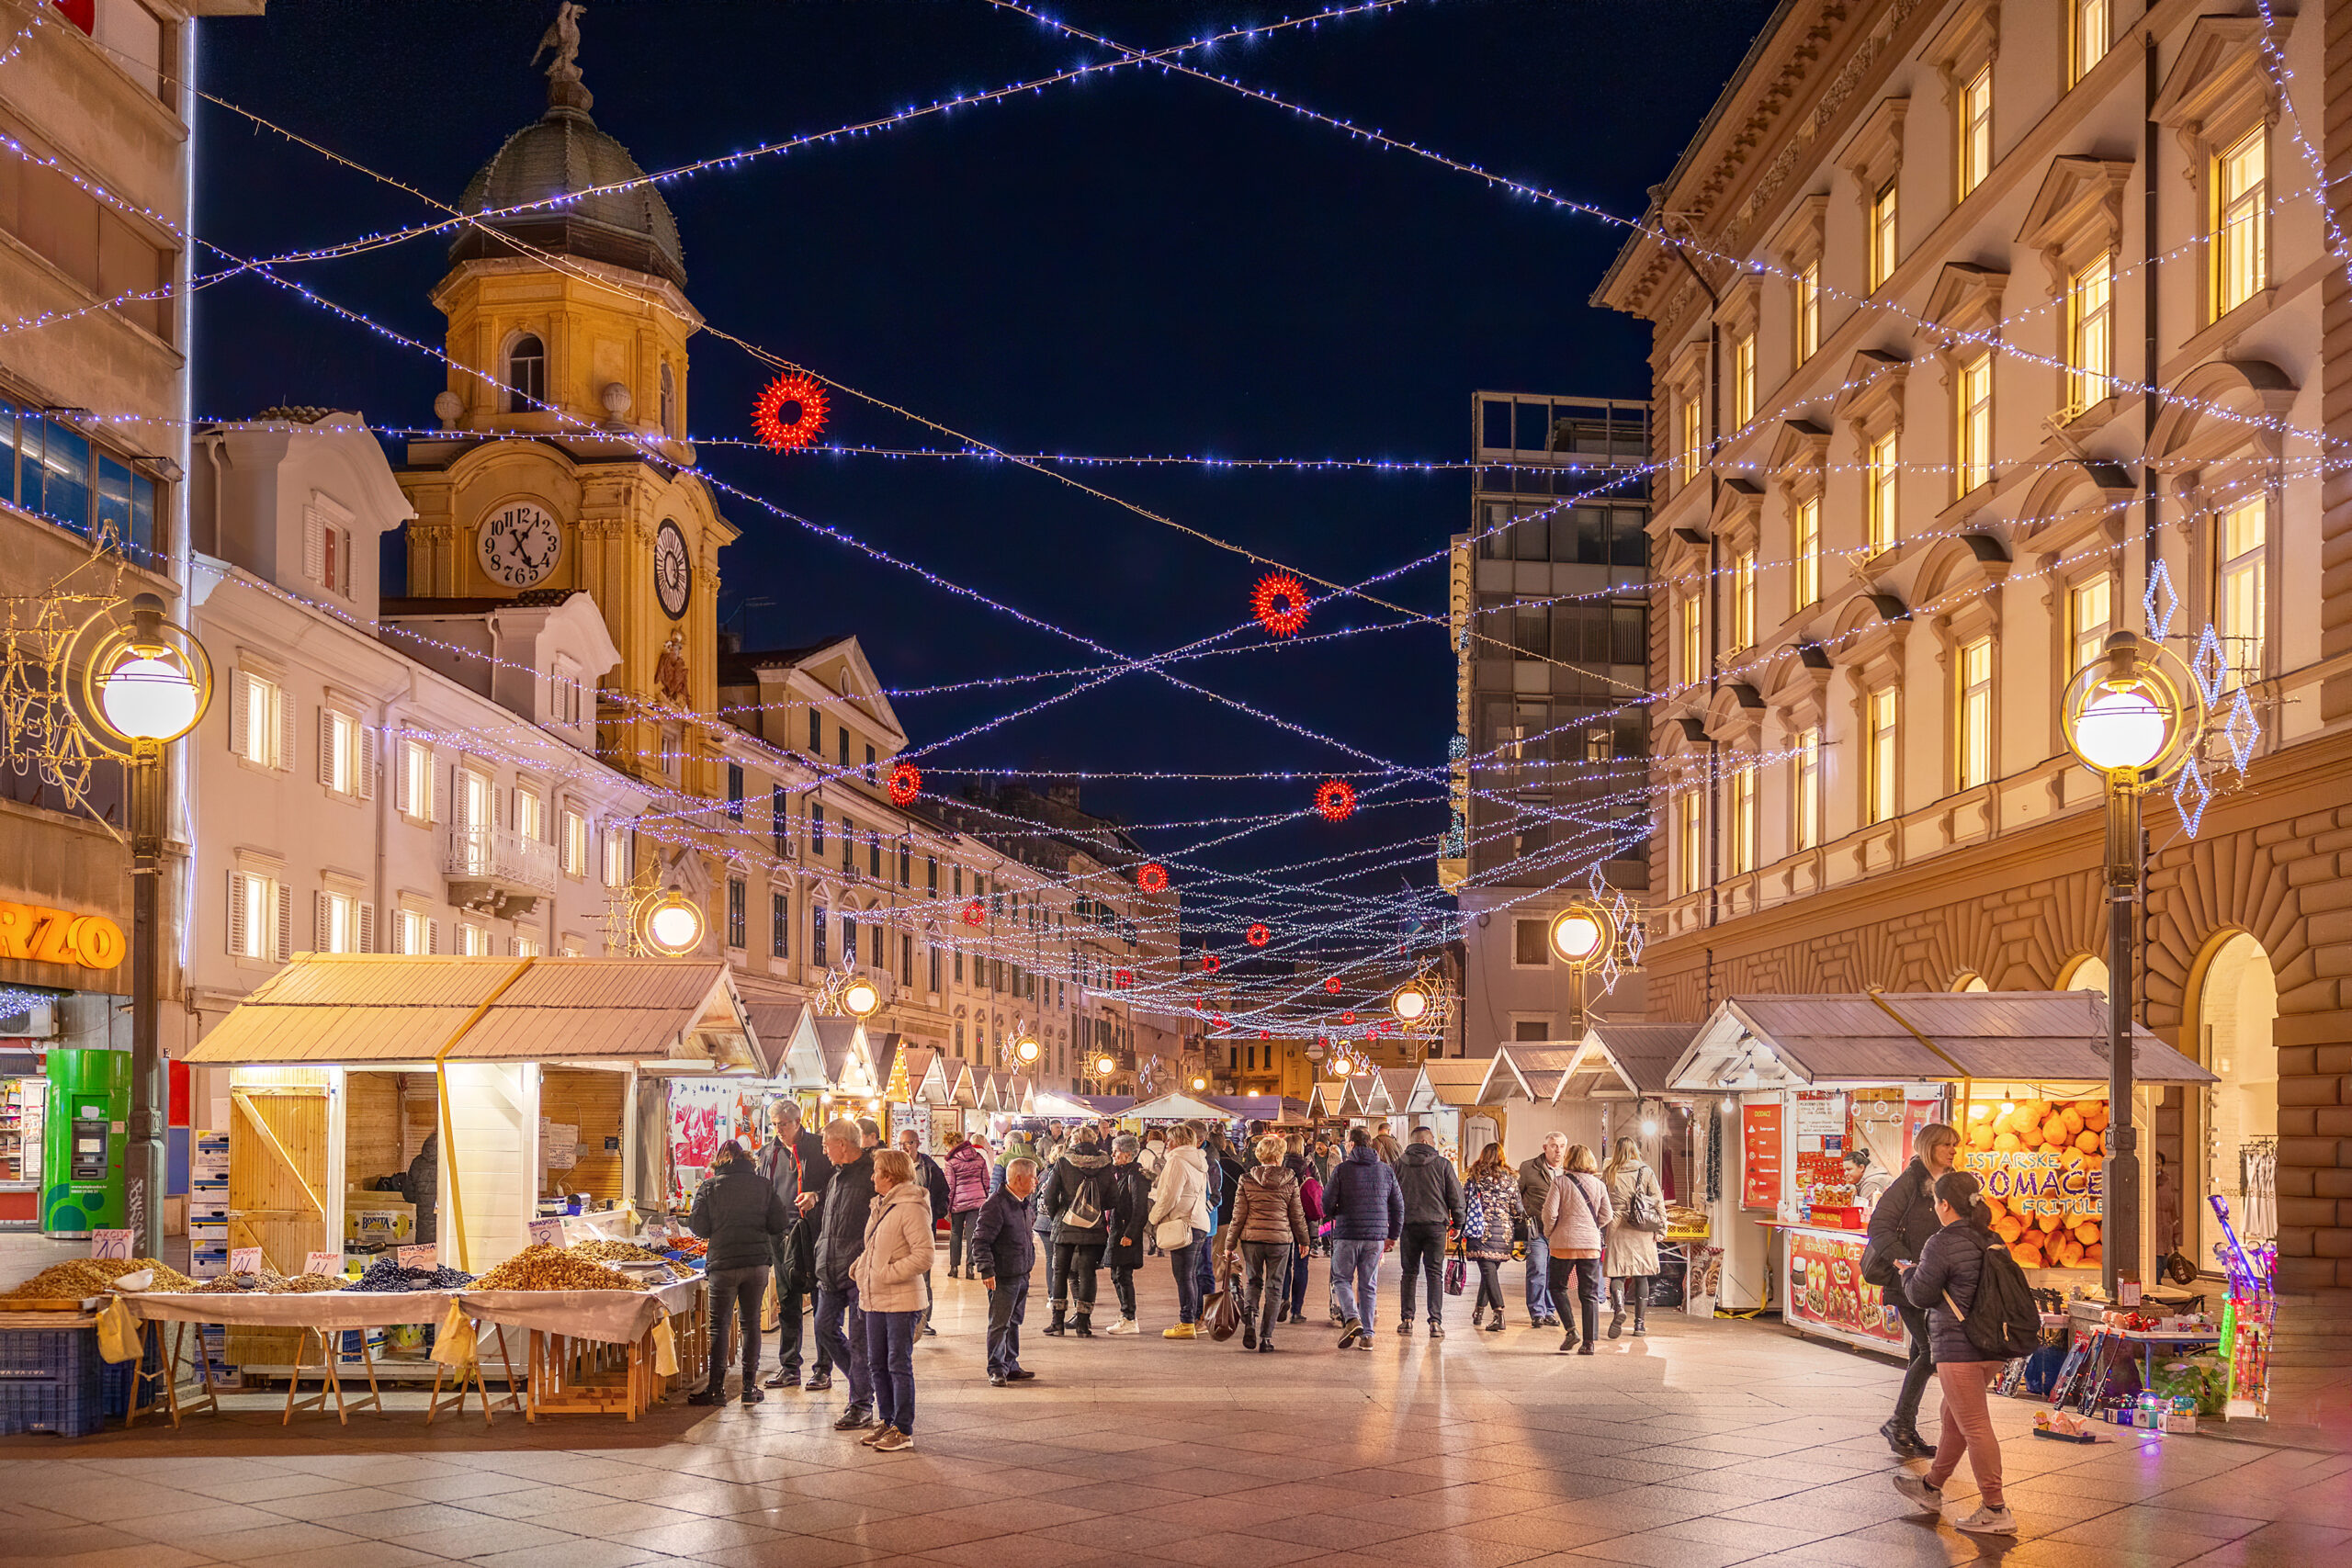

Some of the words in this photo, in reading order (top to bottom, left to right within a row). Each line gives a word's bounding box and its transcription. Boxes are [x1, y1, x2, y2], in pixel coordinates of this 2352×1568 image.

[504, 511, 514, 528] 11
[516, 507, 531, 524] 12
[491, 519, 504, 536] 10
[542, 519, 550, 535] 2
[485, 537, 494, 555] 9
[548, 536, 557, 553] 3
[491, 555, 501, 571] 8
[540, 552, 550, 569] 4
[504, 566, 514, 581] 7
[514, 568, 526, 584] 6
[529, 565, 539, 581] 5
[1965, 1153, 2062, 1168] ISTARSKE
[2221, 1186, 2243, 1200] Happy
[2022, 1199, 2103, 1214] FRITULE
[362, 1217, 390, 1229] BONITA
[96, 1239, 126, 1259] 10
